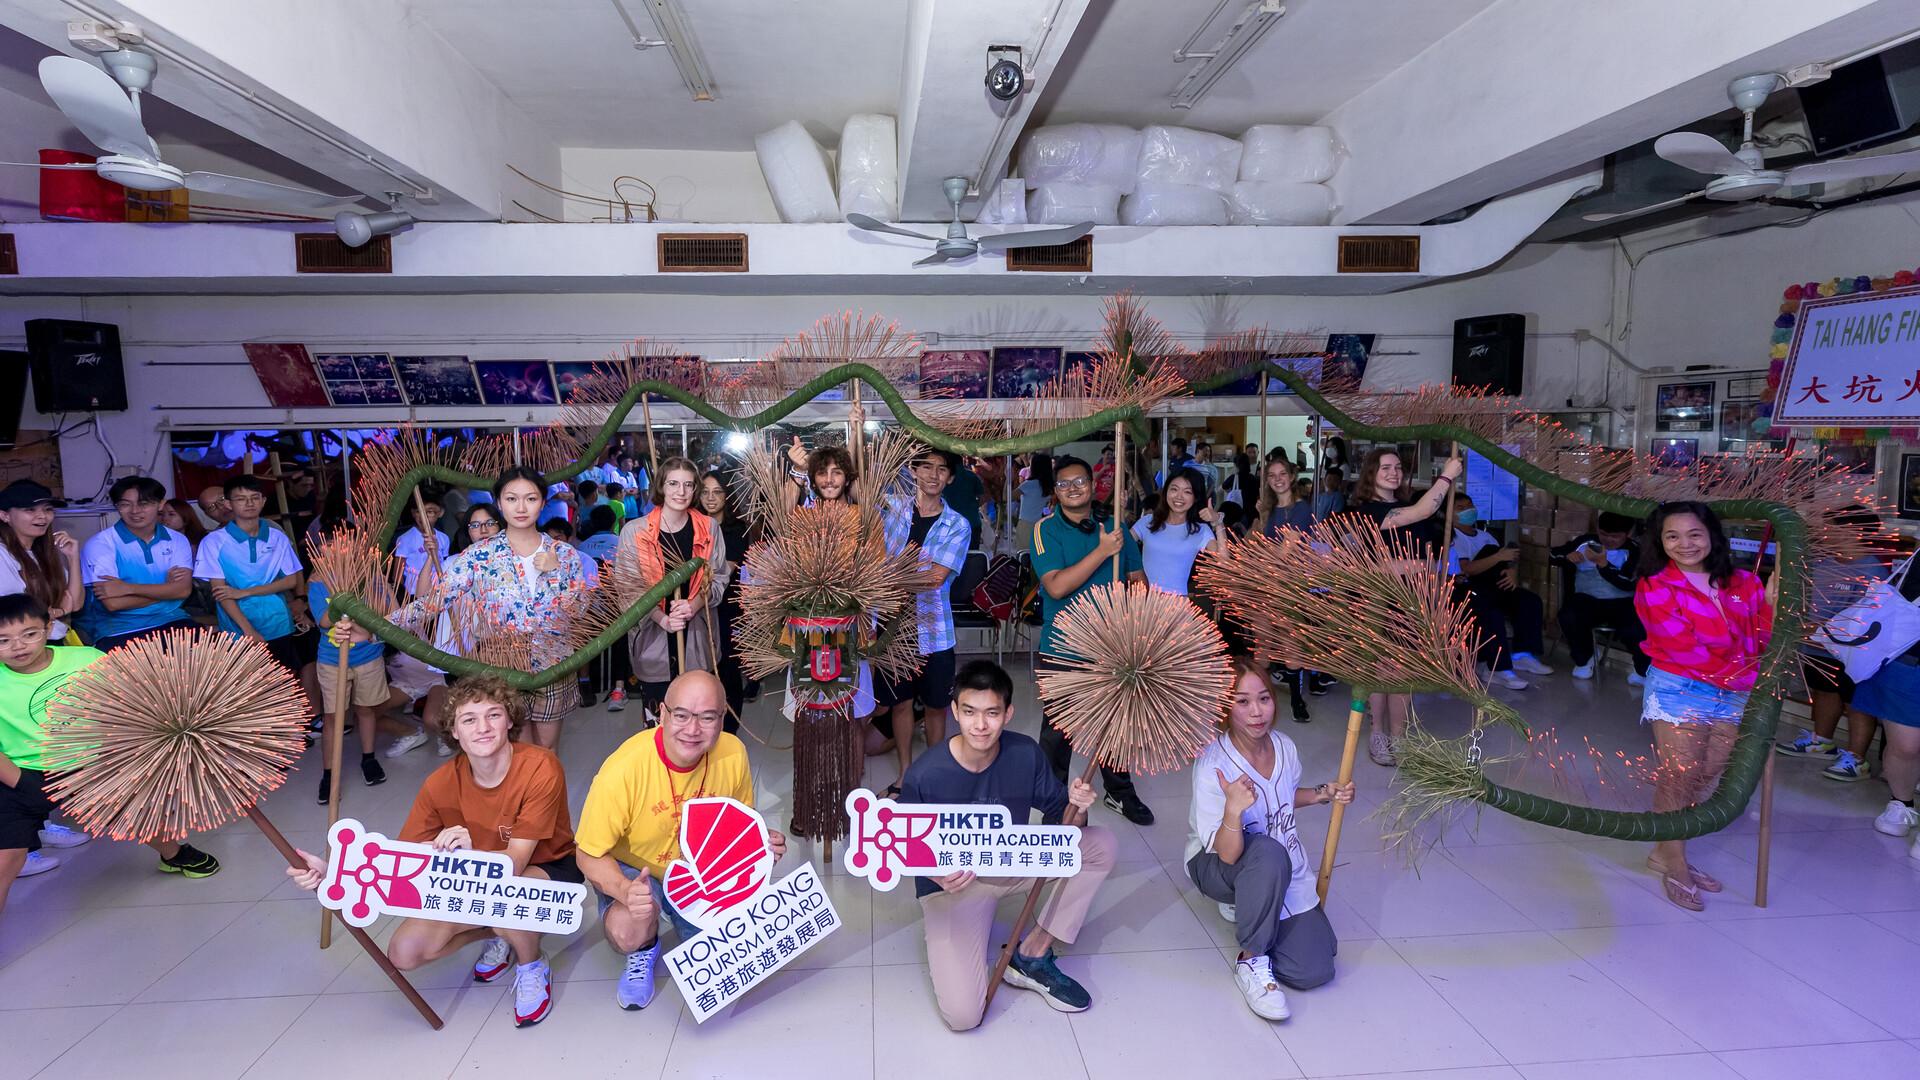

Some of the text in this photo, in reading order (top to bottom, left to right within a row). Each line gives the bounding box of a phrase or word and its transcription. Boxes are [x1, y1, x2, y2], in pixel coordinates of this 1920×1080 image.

[1813, 317, 1841, 350] TAI
[1841, 312, 1892, 346] HANG
[939, 813, 1004, 829] HKTB
[939, 833, 1073, 847] YOUTH ACADEMY
[431, 855, 503, 879] HKTB
[938, 851, 1074, 867] 旅發局青年學院
[429, 876, 577, 905] YOUTH ACADEMY
[424, 893, 572, 925] 旅發局青年學院
[673, 871, 814, 974] HONG KONG
[684, 892, 823, 991] TOURISM BOARD
[696, 908, 834, 1012] 香港旅遊發展局
